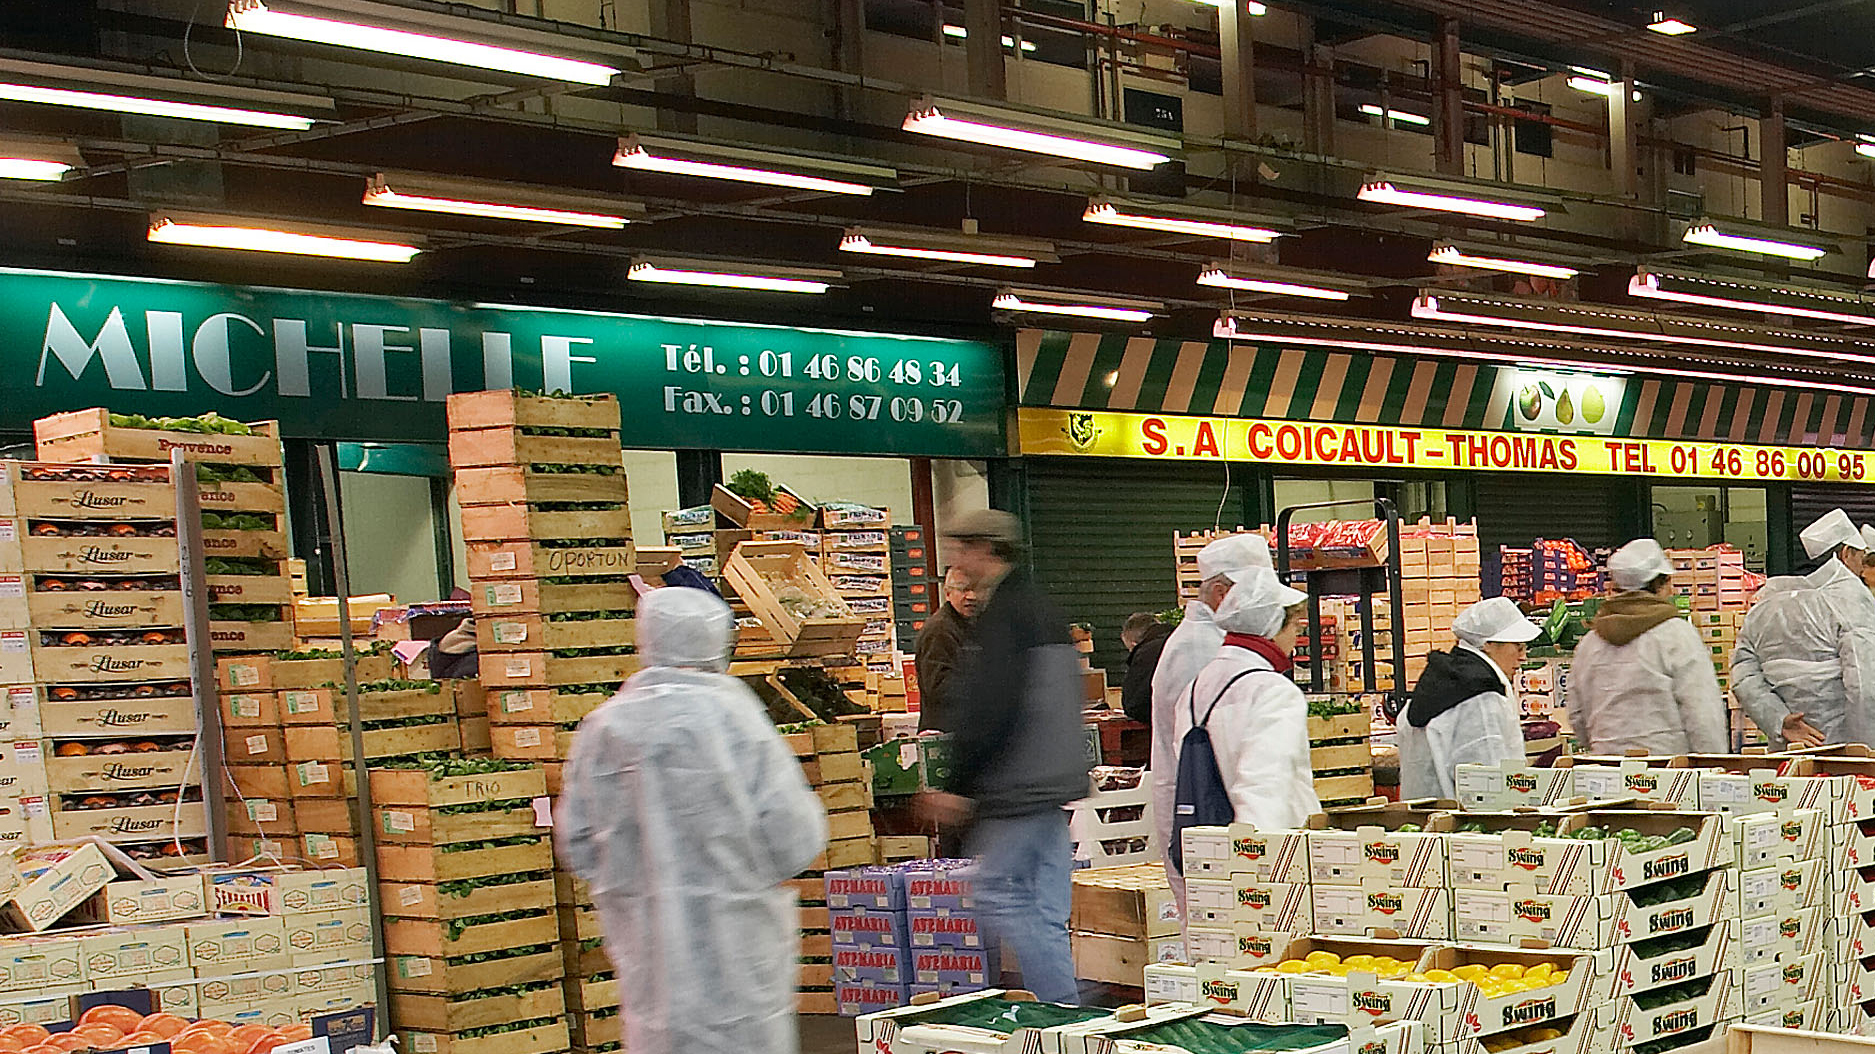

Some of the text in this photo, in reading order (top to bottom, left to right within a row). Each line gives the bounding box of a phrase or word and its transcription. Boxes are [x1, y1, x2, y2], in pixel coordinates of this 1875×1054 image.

[36, 302, 597, 401] MICHELLE
[660, 344, 726, 374] Tél.
[758, 350, 793, 377] 01
[803, 354, 840, 380] 46
[847, 356, 881, 383] 86
[888, 359, 922, 385] 48
[929, 361, 962, 387] 34
[663, 386, 733, 415] Fax.
[761, 390, 795, 417] 01
[805, 392, 841, 419] 46
[849, 395, 882, 421] 87
[890, 397, 924, 422] 09
[931, 399, 964, 424] 52
[158, 438, 231, 455] Provence
[1671, 447, 1698, 475] 01
[1711, 448, 1742, 477] 46
[1756, 450, 1786, 478] 86
[1798, 451, 1827, 480] 00
[1837, 453, 1865, 480] 95
[550, 551, 628, 575] OPORTUN
[1505, 773, 1537, 792] Swing
[1625, 775, 1658, 790] Swing
[1754, 783, 1787, 800] Swing
[1234, 838, 1267, 858] Swing
[1364, 843, 1399, 862] Swing
[1508, 847, 1544, 869] Swing
[1643, 854, 1689, 880] Swing
[1238, 888, 1271, 907] Swing
[1368, 892, 1402, 913] Swing
[1514, 900, 1551, 922] Swing
[1649, 909, 1694, 934] Swing
[1239, 937, 1271, 955] Swing
[1651, 956, 1696, 984] Swing
[1202, 980, 1238, 1004] Swing
[1352, 990, 1390, 1012] Swing
[1502, 997, 1555, 1028] Swing
[1653, 1009, 1698, 1036] Swing
